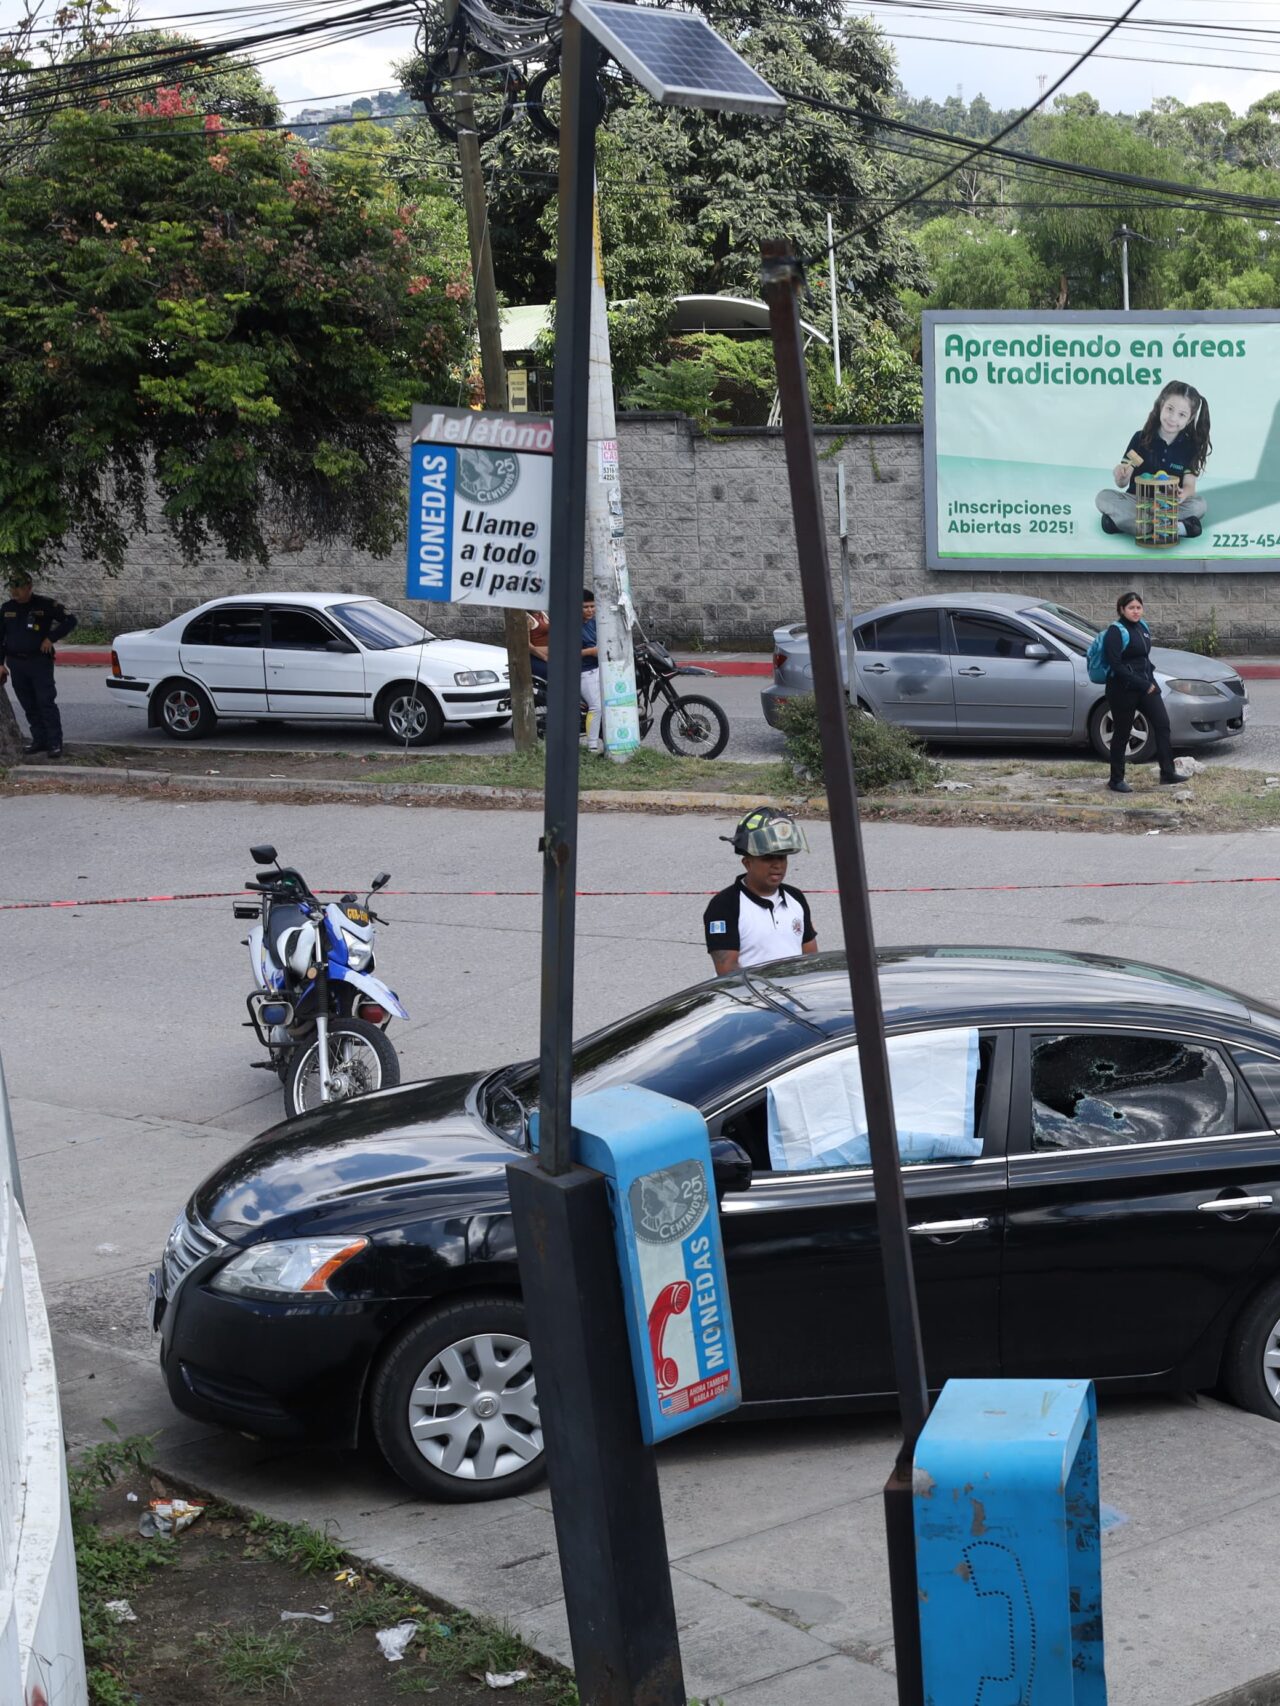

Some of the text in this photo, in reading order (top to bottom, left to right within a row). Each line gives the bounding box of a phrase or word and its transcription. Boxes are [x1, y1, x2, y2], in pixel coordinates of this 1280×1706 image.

[944, 333, 1246, 361] Aprendiendo en áreas
[945, 361, 1162, 385] no tradicionales
[430, 413, 552, 449] Teléfono
[495, 458, 515, 475] 25
[419, 455, 448, 588] MONEDAS
[948, 499, 1072, 518] ¡Inscripciones
[461, 509, 537, 538] Llame
[947, 519, 1073, 534] Abiertas 2025!
[460, 541, 537, 566] a todo
[460, 566, 543, 596] el país
[681, 1175, 703, 1199] 25
[659, 1194, 702, 1238] CENTAVOS
[691, 1236, 725, 1370] MONEDAS
